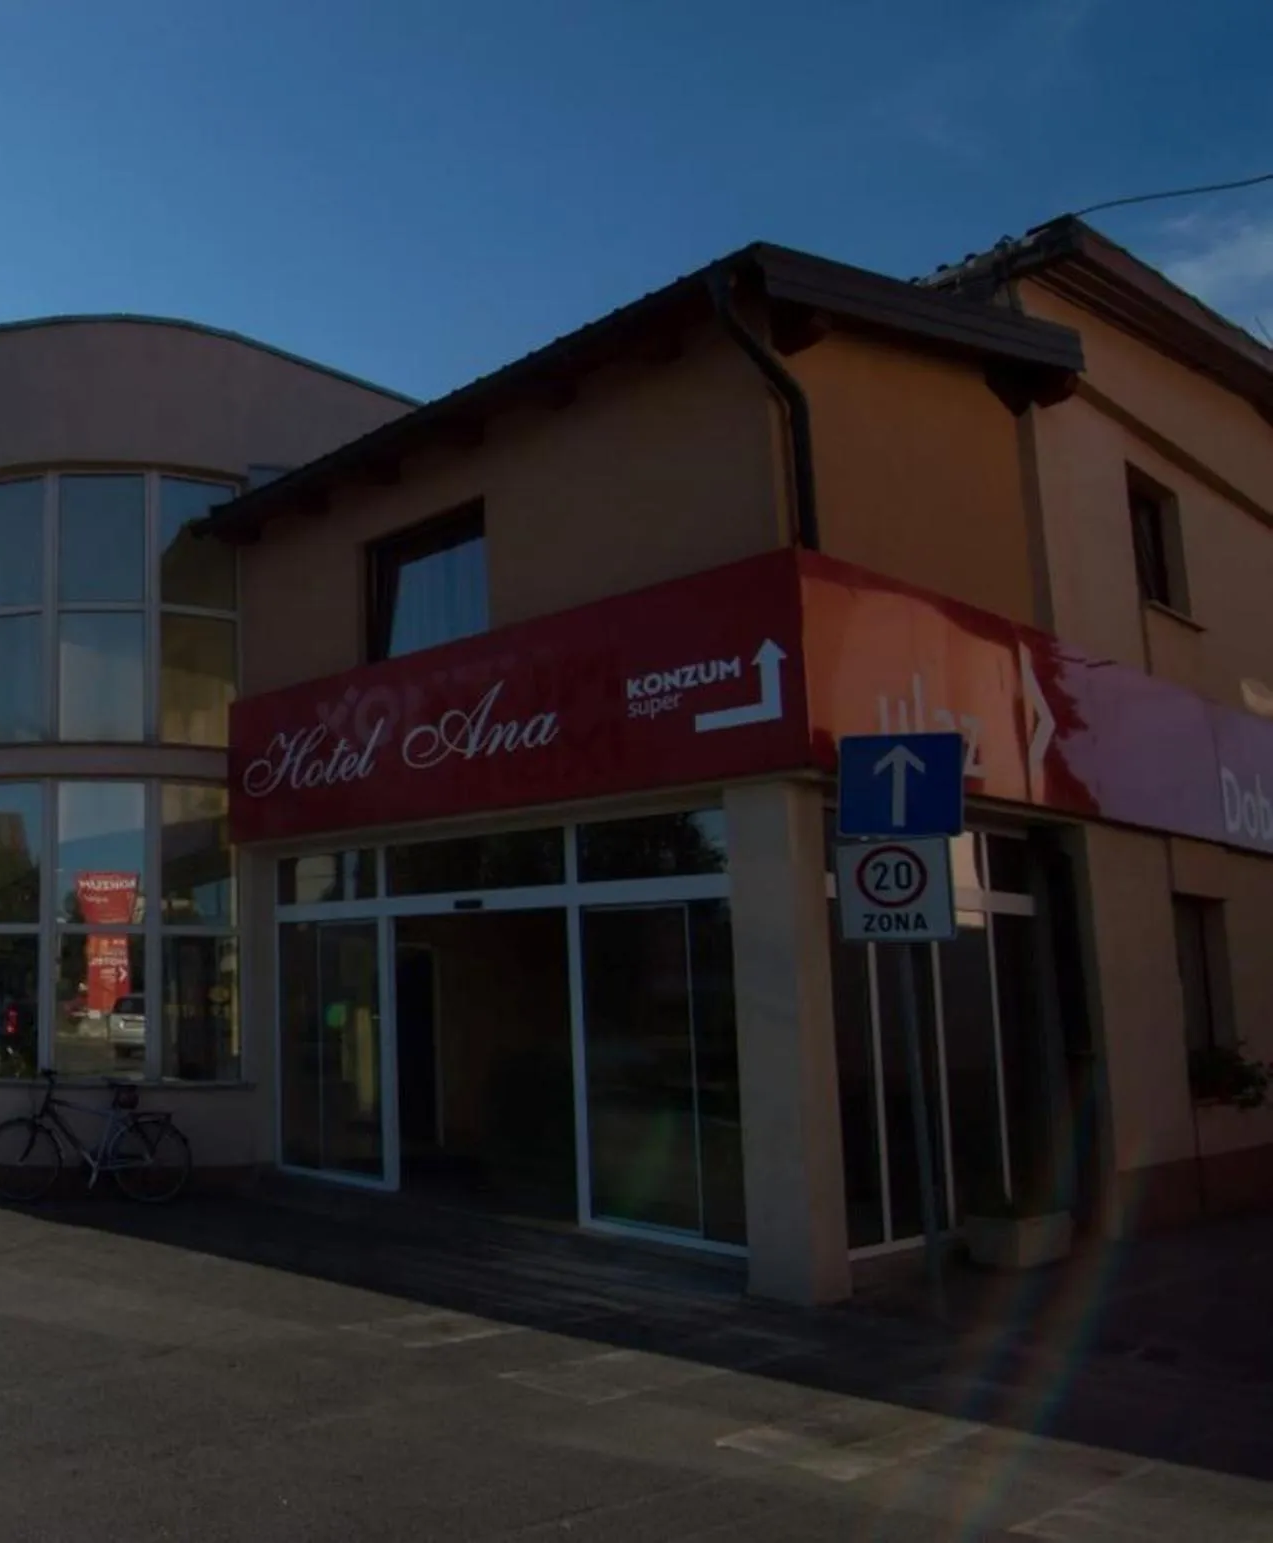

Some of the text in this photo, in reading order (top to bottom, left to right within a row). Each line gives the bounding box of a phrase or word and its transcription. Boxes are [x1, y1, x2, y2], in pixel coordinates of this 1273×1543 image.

[626, 655, 741, 699] KONZUM
[627, 691, 683, 721] super
[241, 717, 386, 798] Hotel
[402, 679, 561, 770] Ana
[871, 861, 913, 891] 20
[862, 913, 929, 933] ZONA
